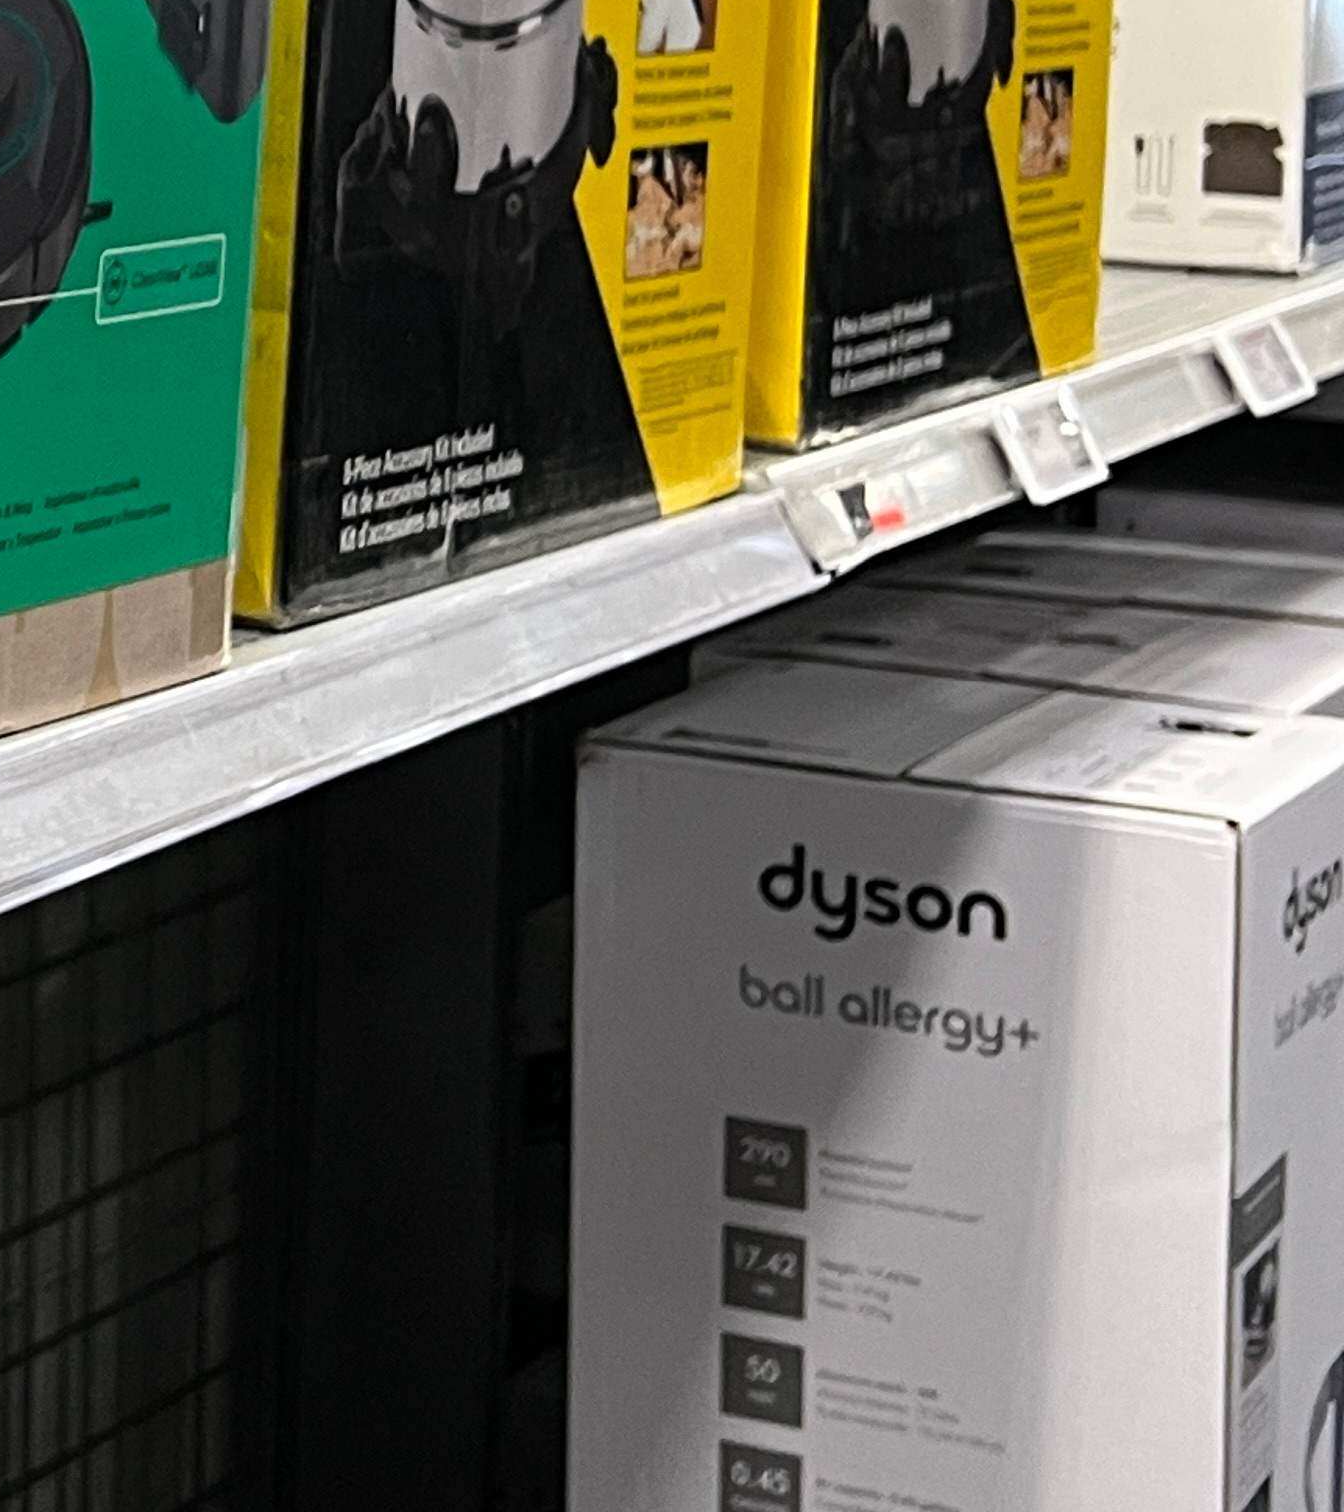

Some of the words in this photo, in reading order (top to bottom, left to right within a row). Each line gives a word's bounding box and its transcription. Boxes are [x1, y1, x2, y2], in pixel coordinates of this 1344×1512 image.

[759, 843, 1007, 942] dyson
[739, 963, 824, 1020] ball
[838, 986, 1039, 1057] allergy+
